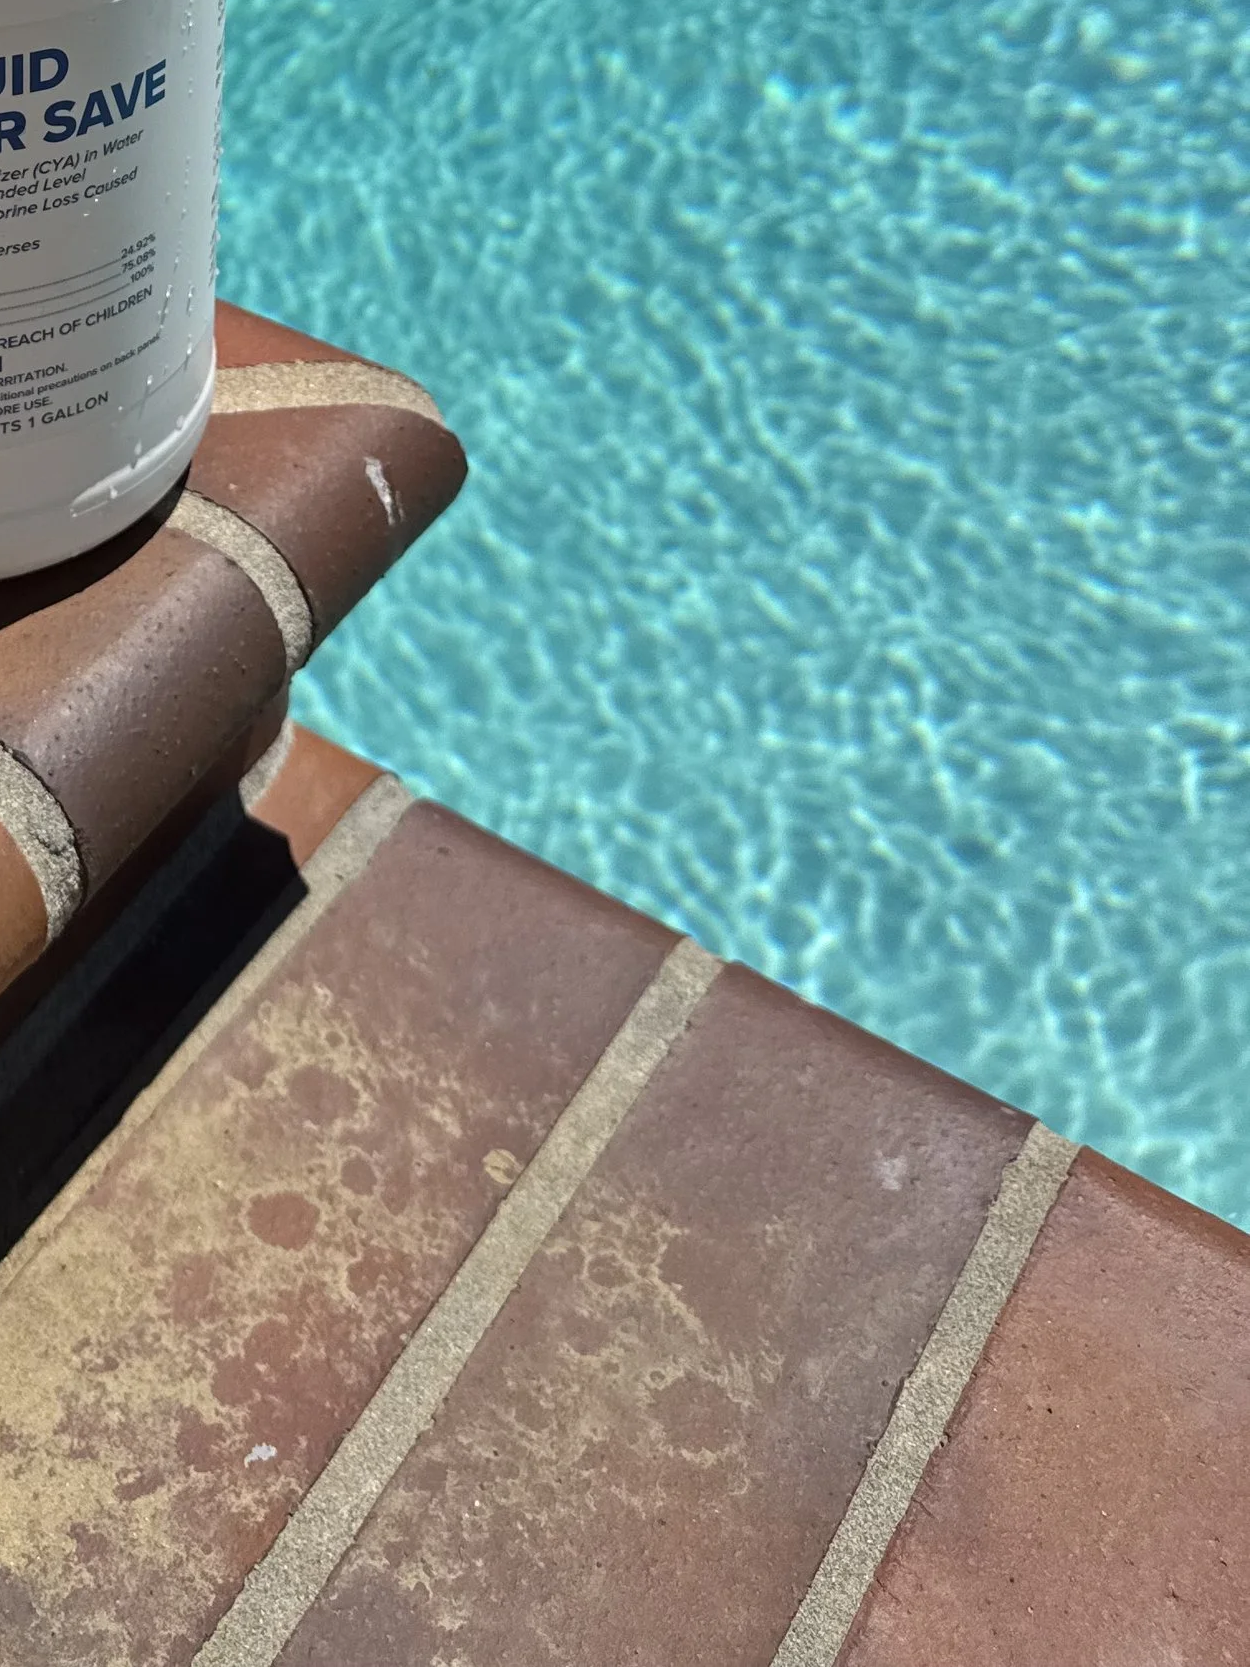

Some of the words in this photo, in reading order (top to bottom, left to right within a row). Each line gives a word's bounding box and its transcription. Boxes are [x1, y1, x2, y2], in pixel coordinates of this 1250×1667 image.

[43, 59, 166, 143] SAVE
[33, 153, 80, 178] (CYA)
[84, 148, 98, 164] in
[103, 129, 144, 157] Water
[42, 194, 79, 212] Loss
[84, 167, 138, 199] Caused
[43, 169, 86, 191] Level
[120, 233, 156, 260] 24.92%
[121, 248, 156, 274] 75.08%
[130, 264, 155, 284] 100%
[59, 319, 83, 335] OF
[85, 285, 153, 325] CHILDREN
[37, 368, 98, 395] precautions
[100, 360, 113, 372] on
[114, 349, 136, 365] back
[24, 397, 53, 412] USE.
[29, 417, 35, 428] 1
[41, 391, 109, 425] GALLON
